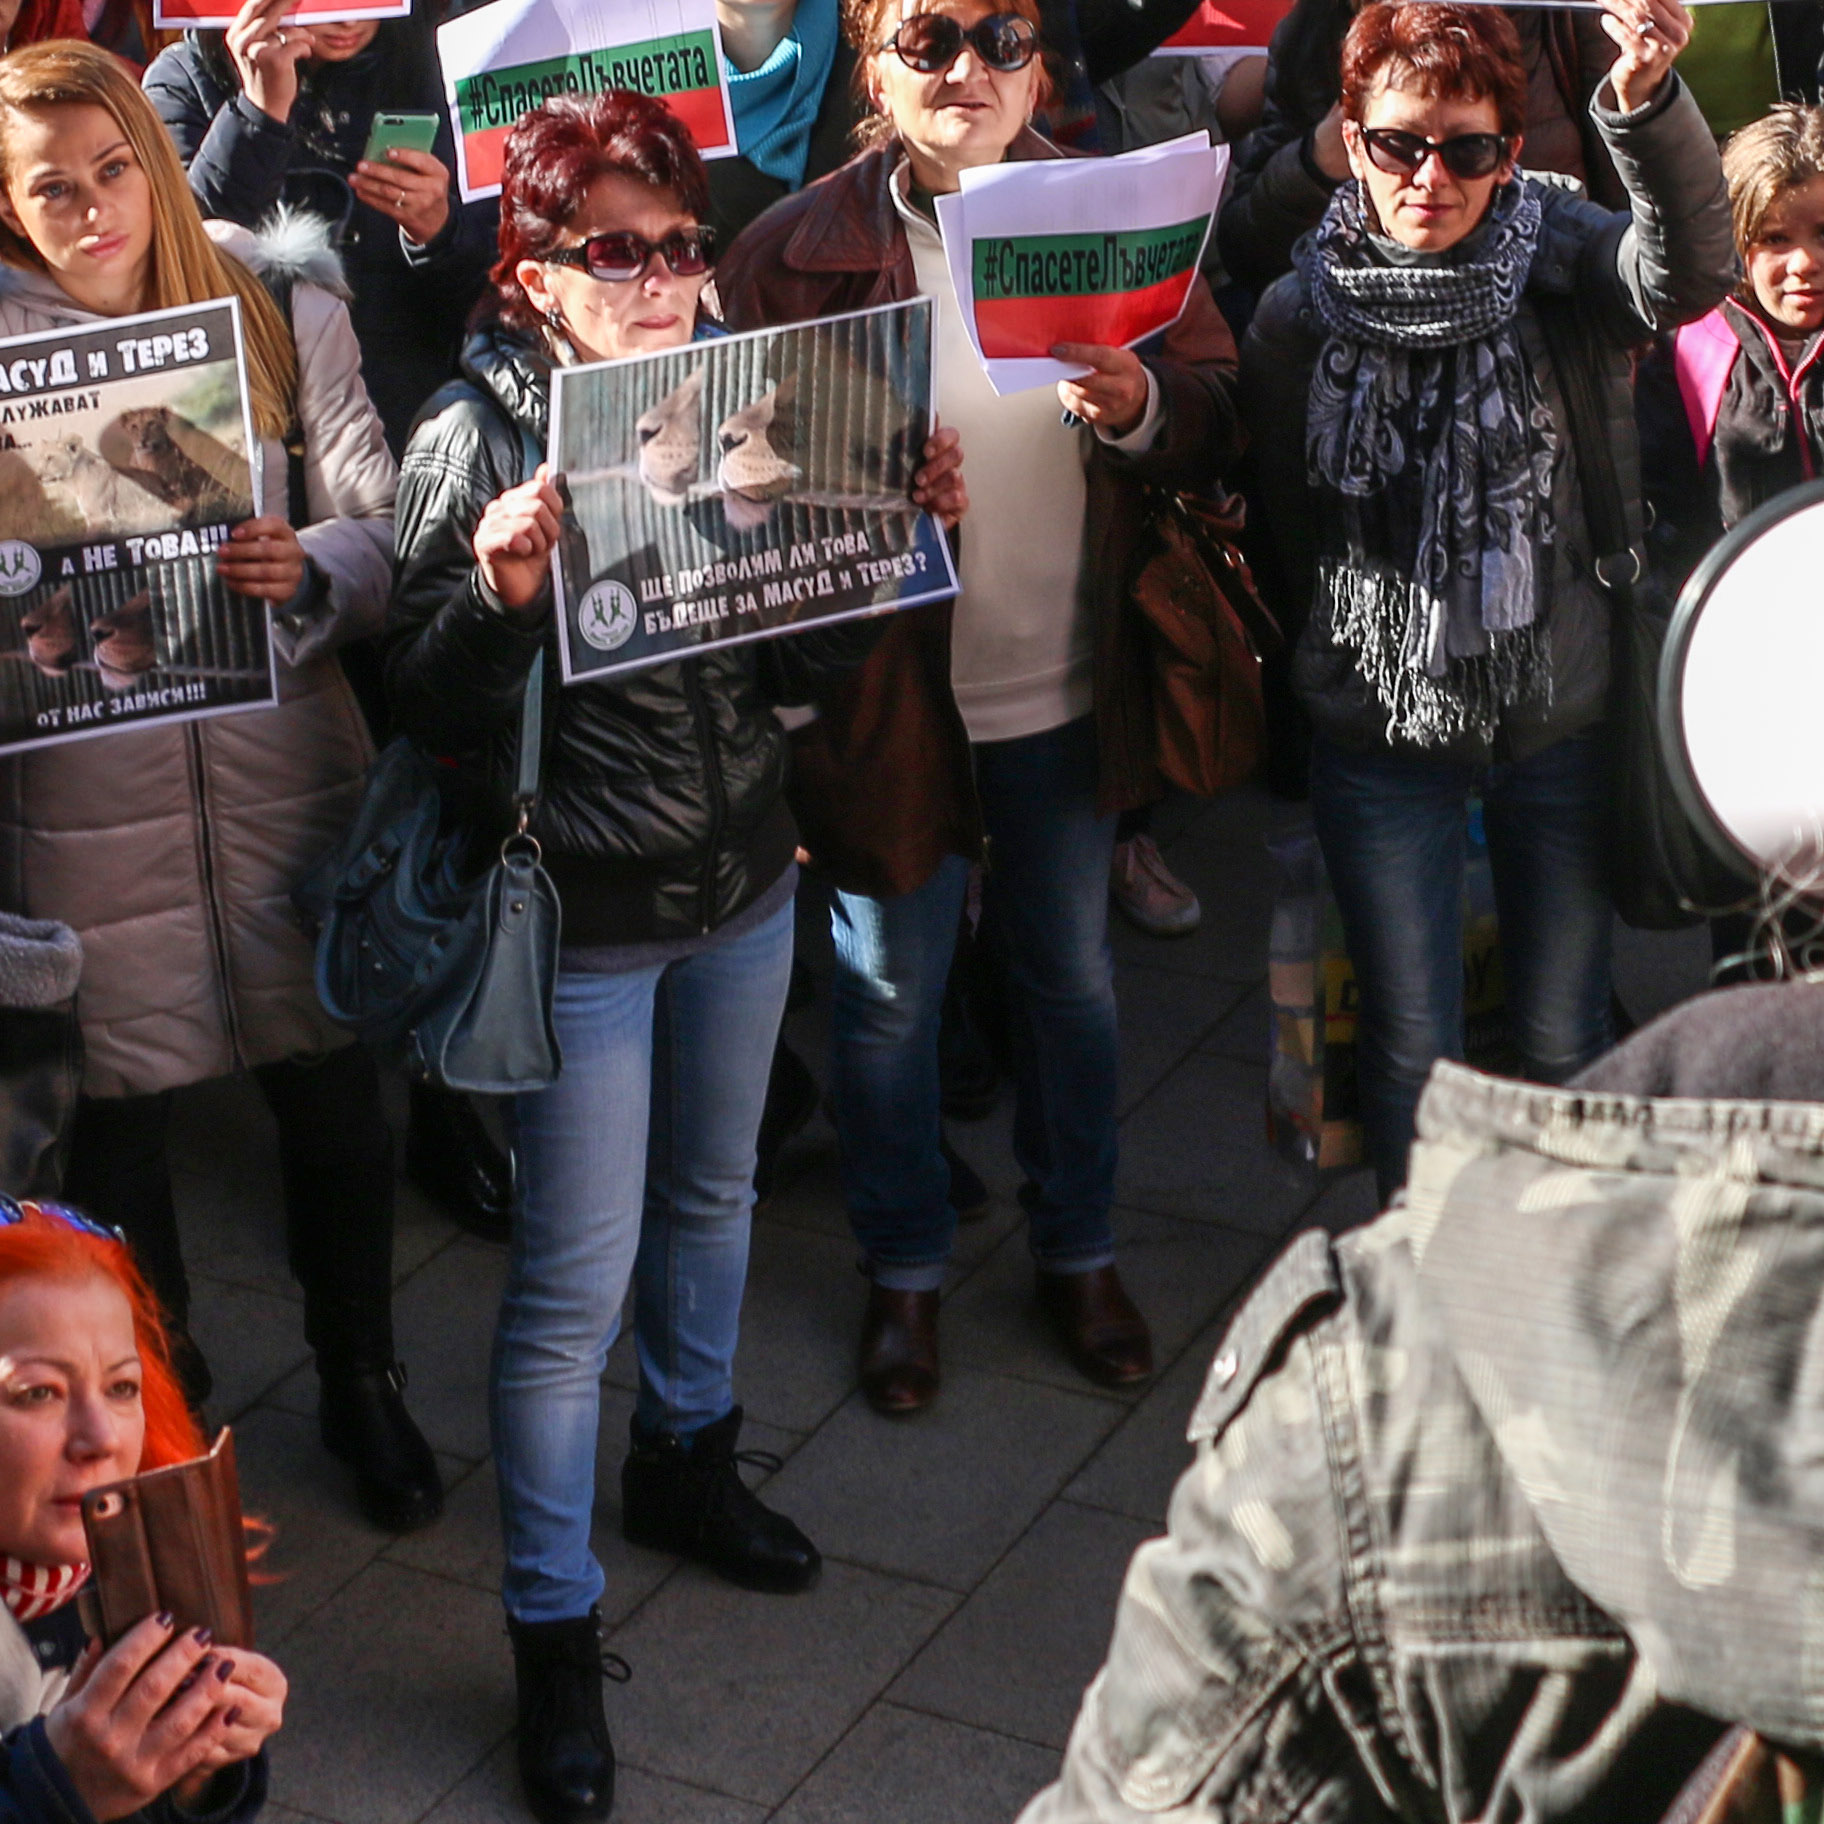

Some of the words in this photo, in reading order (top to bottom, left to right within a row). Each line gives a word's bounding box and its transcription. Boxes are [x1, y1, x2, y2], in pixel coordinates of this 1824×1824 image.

[982, 213, 1200, 299] #СпасетеЛъвчетата
[116, 327, 209, 374] ТЕРЕЗ
[84, 542, 121, 572] НЕ
[126, 523, 230, 561] ТОВА!!!
[640, 575, 674, 602] ЩЕ
[678, 549, 782, 594] ПОЗВОЛИМ
[789, 543, 816, 569] ЛИ
[821, 530, 870, 562] ТОВА
[644, 599, 730, 635] БЪДЕЩЕ
[763, 570, 834, 608] МАСУД
[856, 552, 926, 586] ТЕРЕЗ?
[36, 708, 61, 728] ОТ
[66, 700, 104, 724] НАС
[109, 683, 206, 717] ЗАВИСИ!!!
